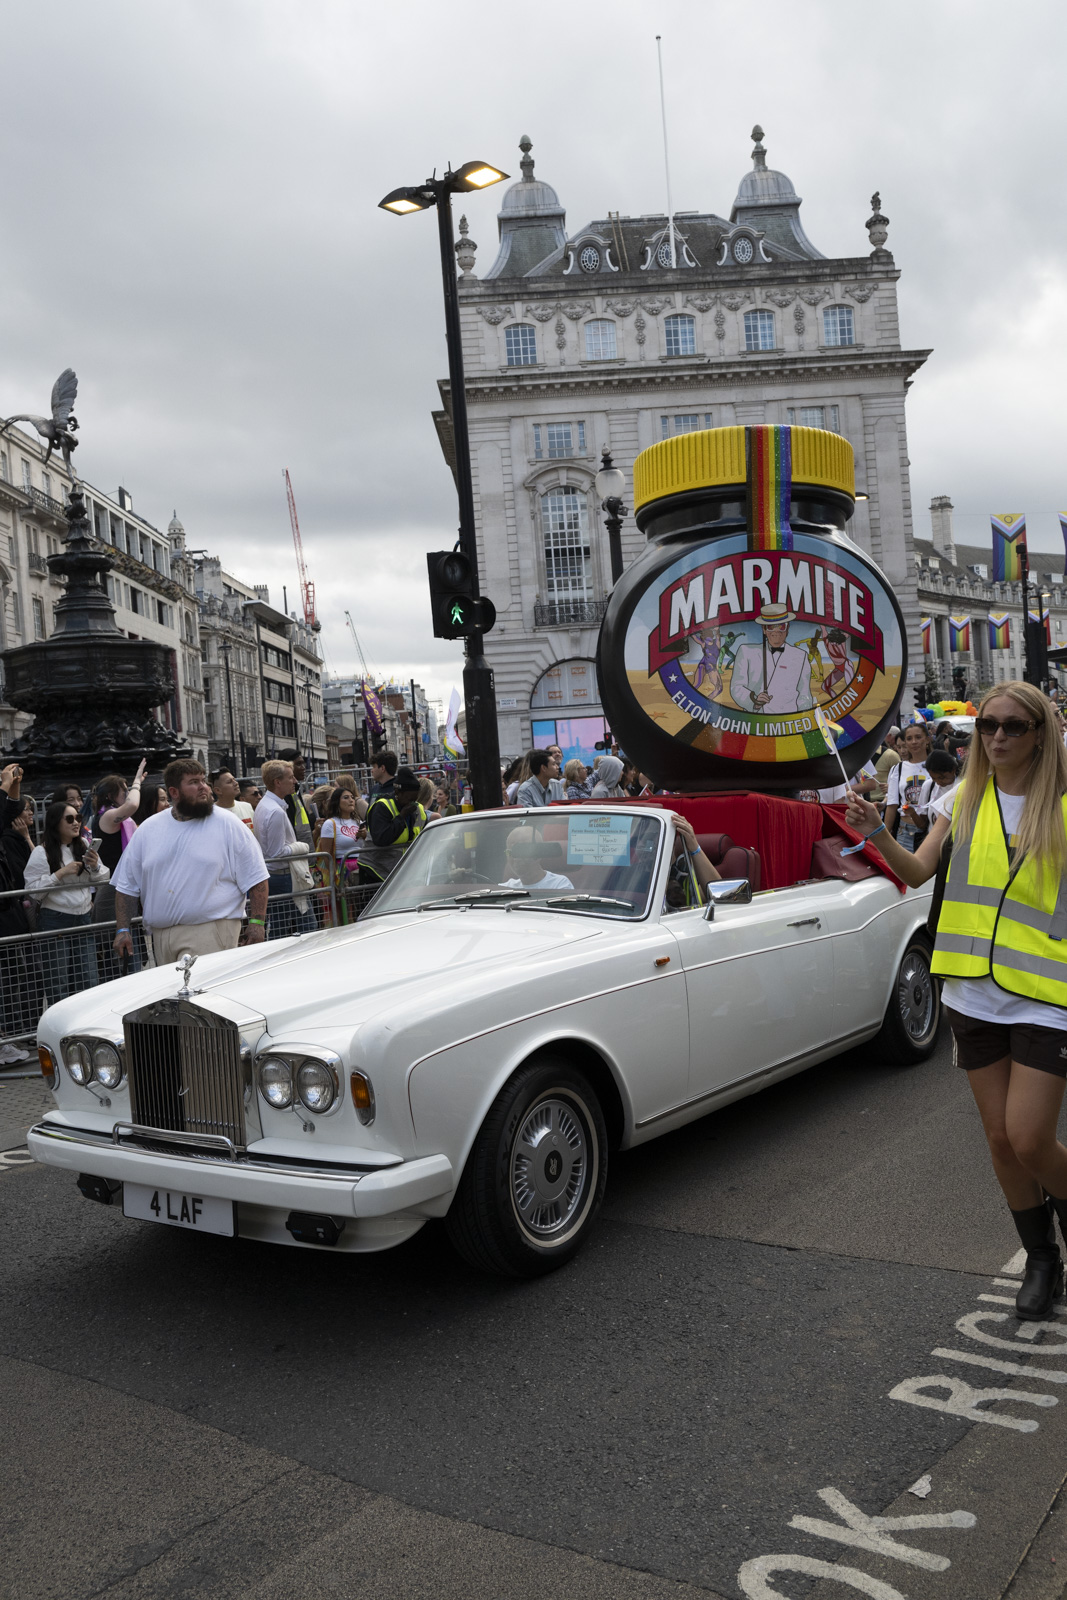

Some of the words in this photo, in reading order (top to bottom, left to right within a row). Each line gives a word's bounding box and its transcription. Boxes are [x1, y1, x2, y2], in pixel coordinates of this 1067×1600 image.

[668, 557, 865, 638] MARMITE
[671, 690, 712, 724] ELTON
[711, 715, 751, 736] JOHN
[755, 717, 812, 736] LIMITED
[814, 687, 859, 722] DITION
[150, 1190, 161, 1217] 4
[167, 1193, 203, 1224] LAF
